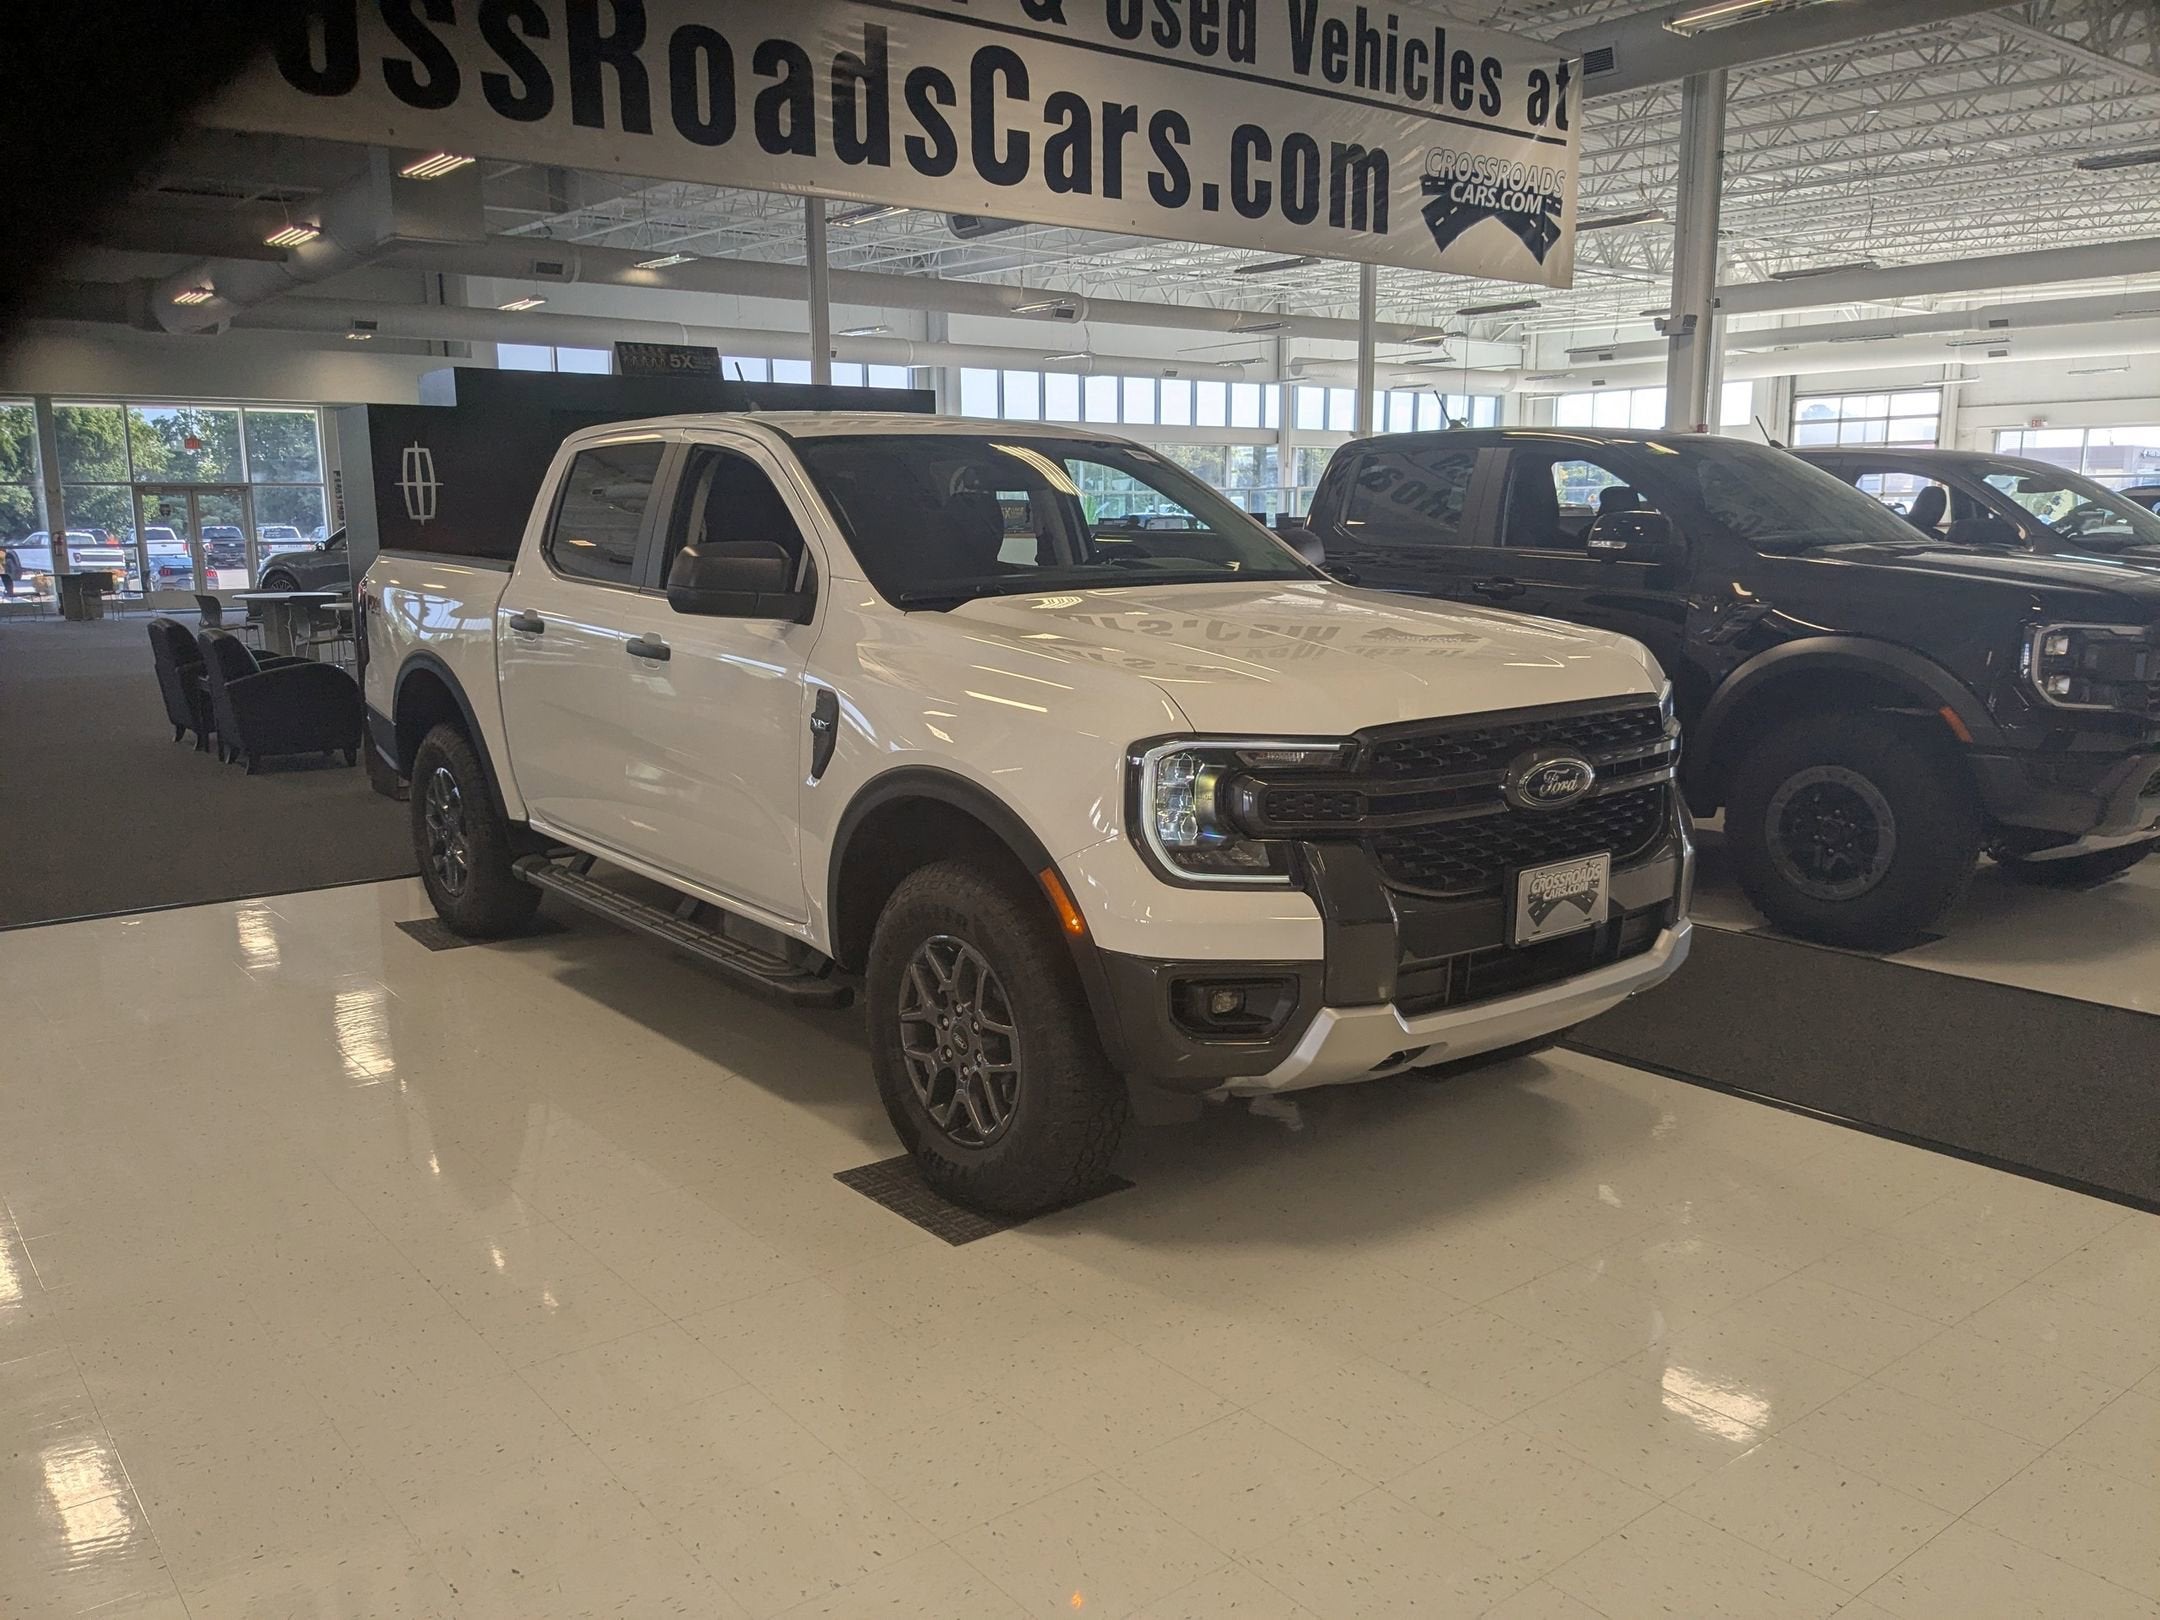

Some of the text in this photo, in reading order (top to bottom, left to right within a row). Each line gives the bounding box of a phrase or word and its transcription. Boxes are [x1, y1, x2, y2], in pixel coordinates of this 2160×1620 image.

[1288, 0, 1503, 118] Vehicles
[1527, 58, 1571, 132] at
[274, 0, 1390, 236] ossRoadsCars.com
[1426, 147, 1566, 198] CROSSROADS
[1451, 182, 1543, 214] CARS.COM
[1540, 768, 1579, 796] Ford
[1531, 864, 1601, 893] CROSSROADS
[1543, 882, 1589, 900] CARS.COM
